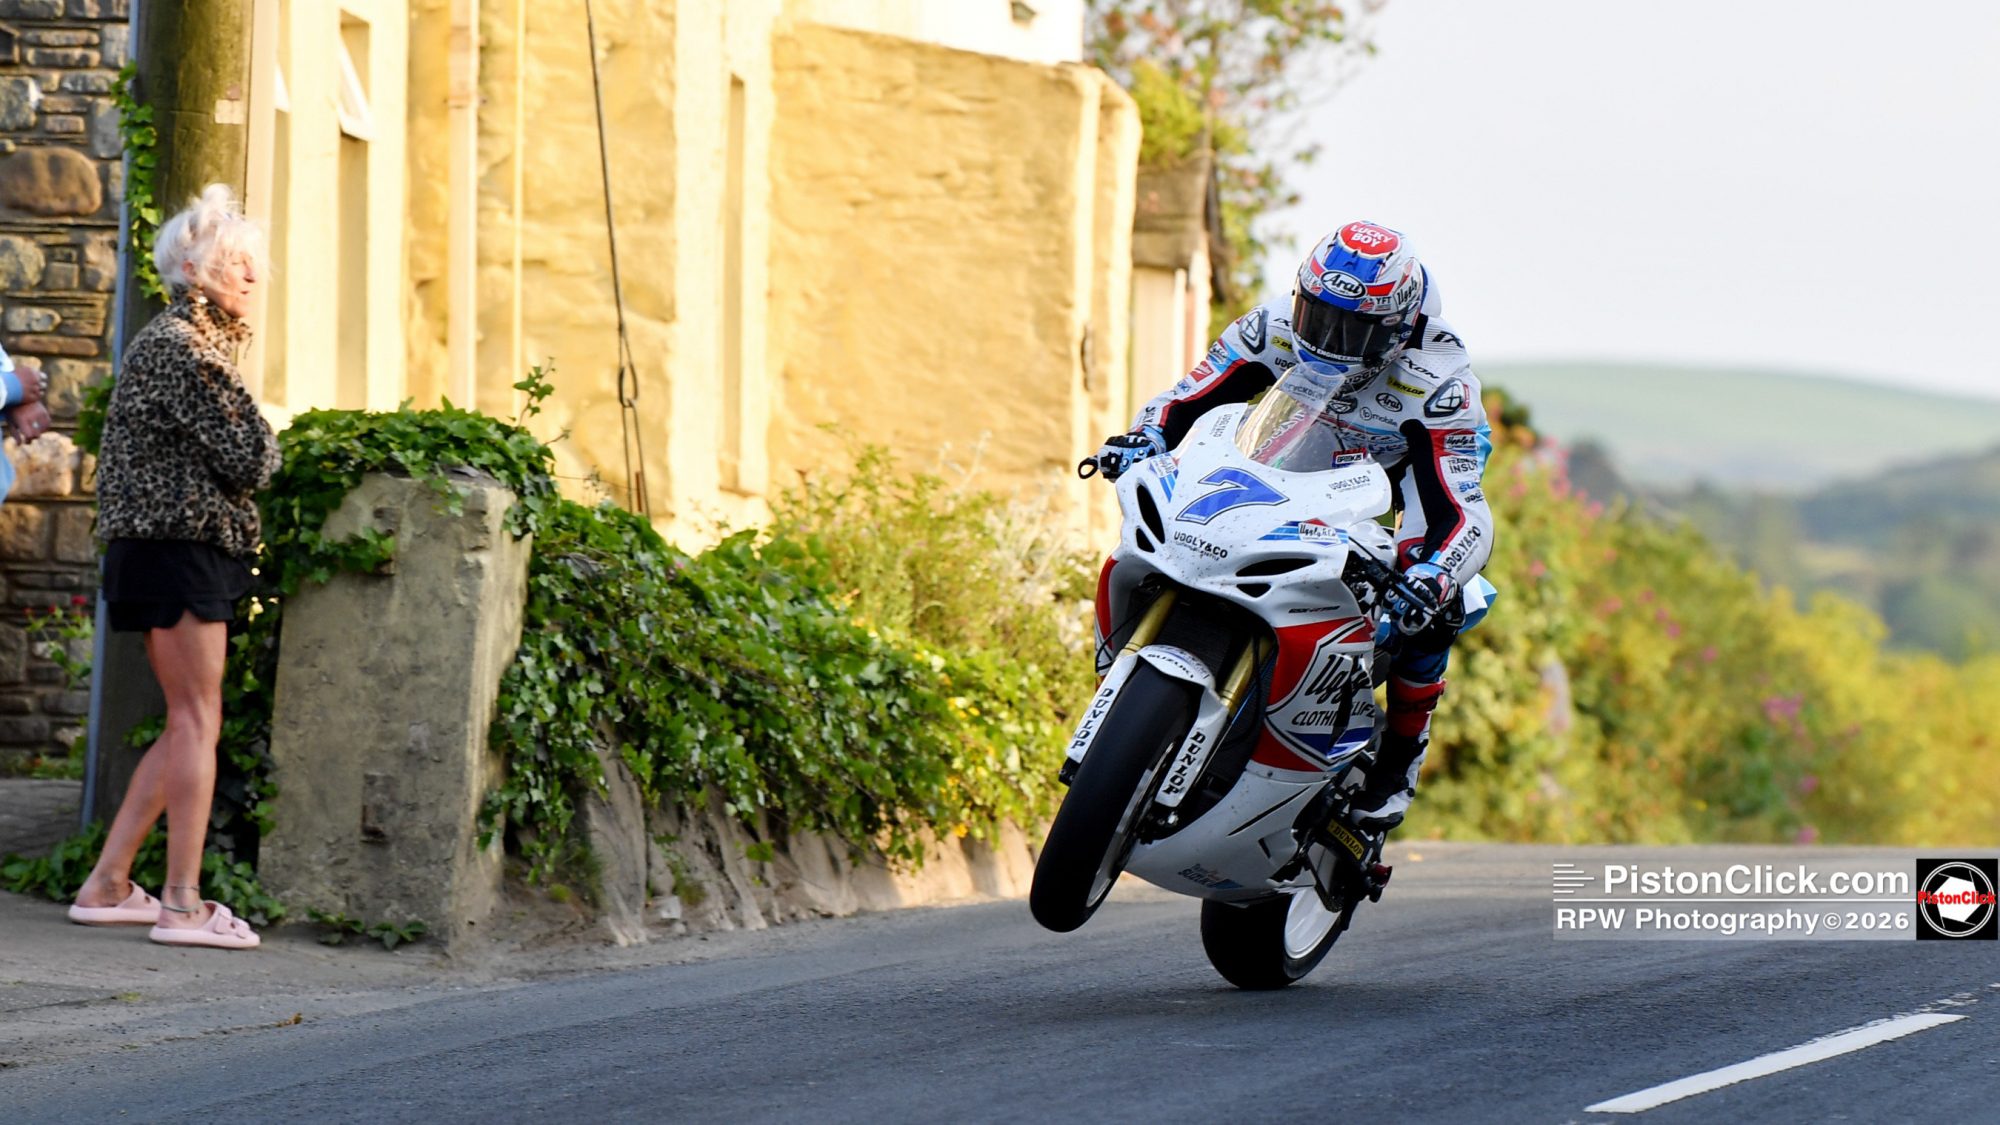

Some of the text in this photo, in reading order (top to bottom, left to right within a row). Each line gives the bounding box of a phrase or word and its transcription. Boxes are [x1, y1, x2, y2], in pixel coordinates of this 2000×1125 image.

[1350, 224, 1393, 243] LUCKY
[1350, 233, 1380, 247] BOY
[1322, 273, 1362, 294] Arai
[1378, 395, 1401, 410] Arai
[1175, 466, 1291, 526] 7
[1147, 653, 1195, 678] SUZUKI
[1071, 687, 1114, 749] DUNLOP
[1291, 710, 1339, 726] CLOTHI
[1162, 731, 1206, 796] DUNLOP
[1333, 825, 1363, 855] DUNLOP
